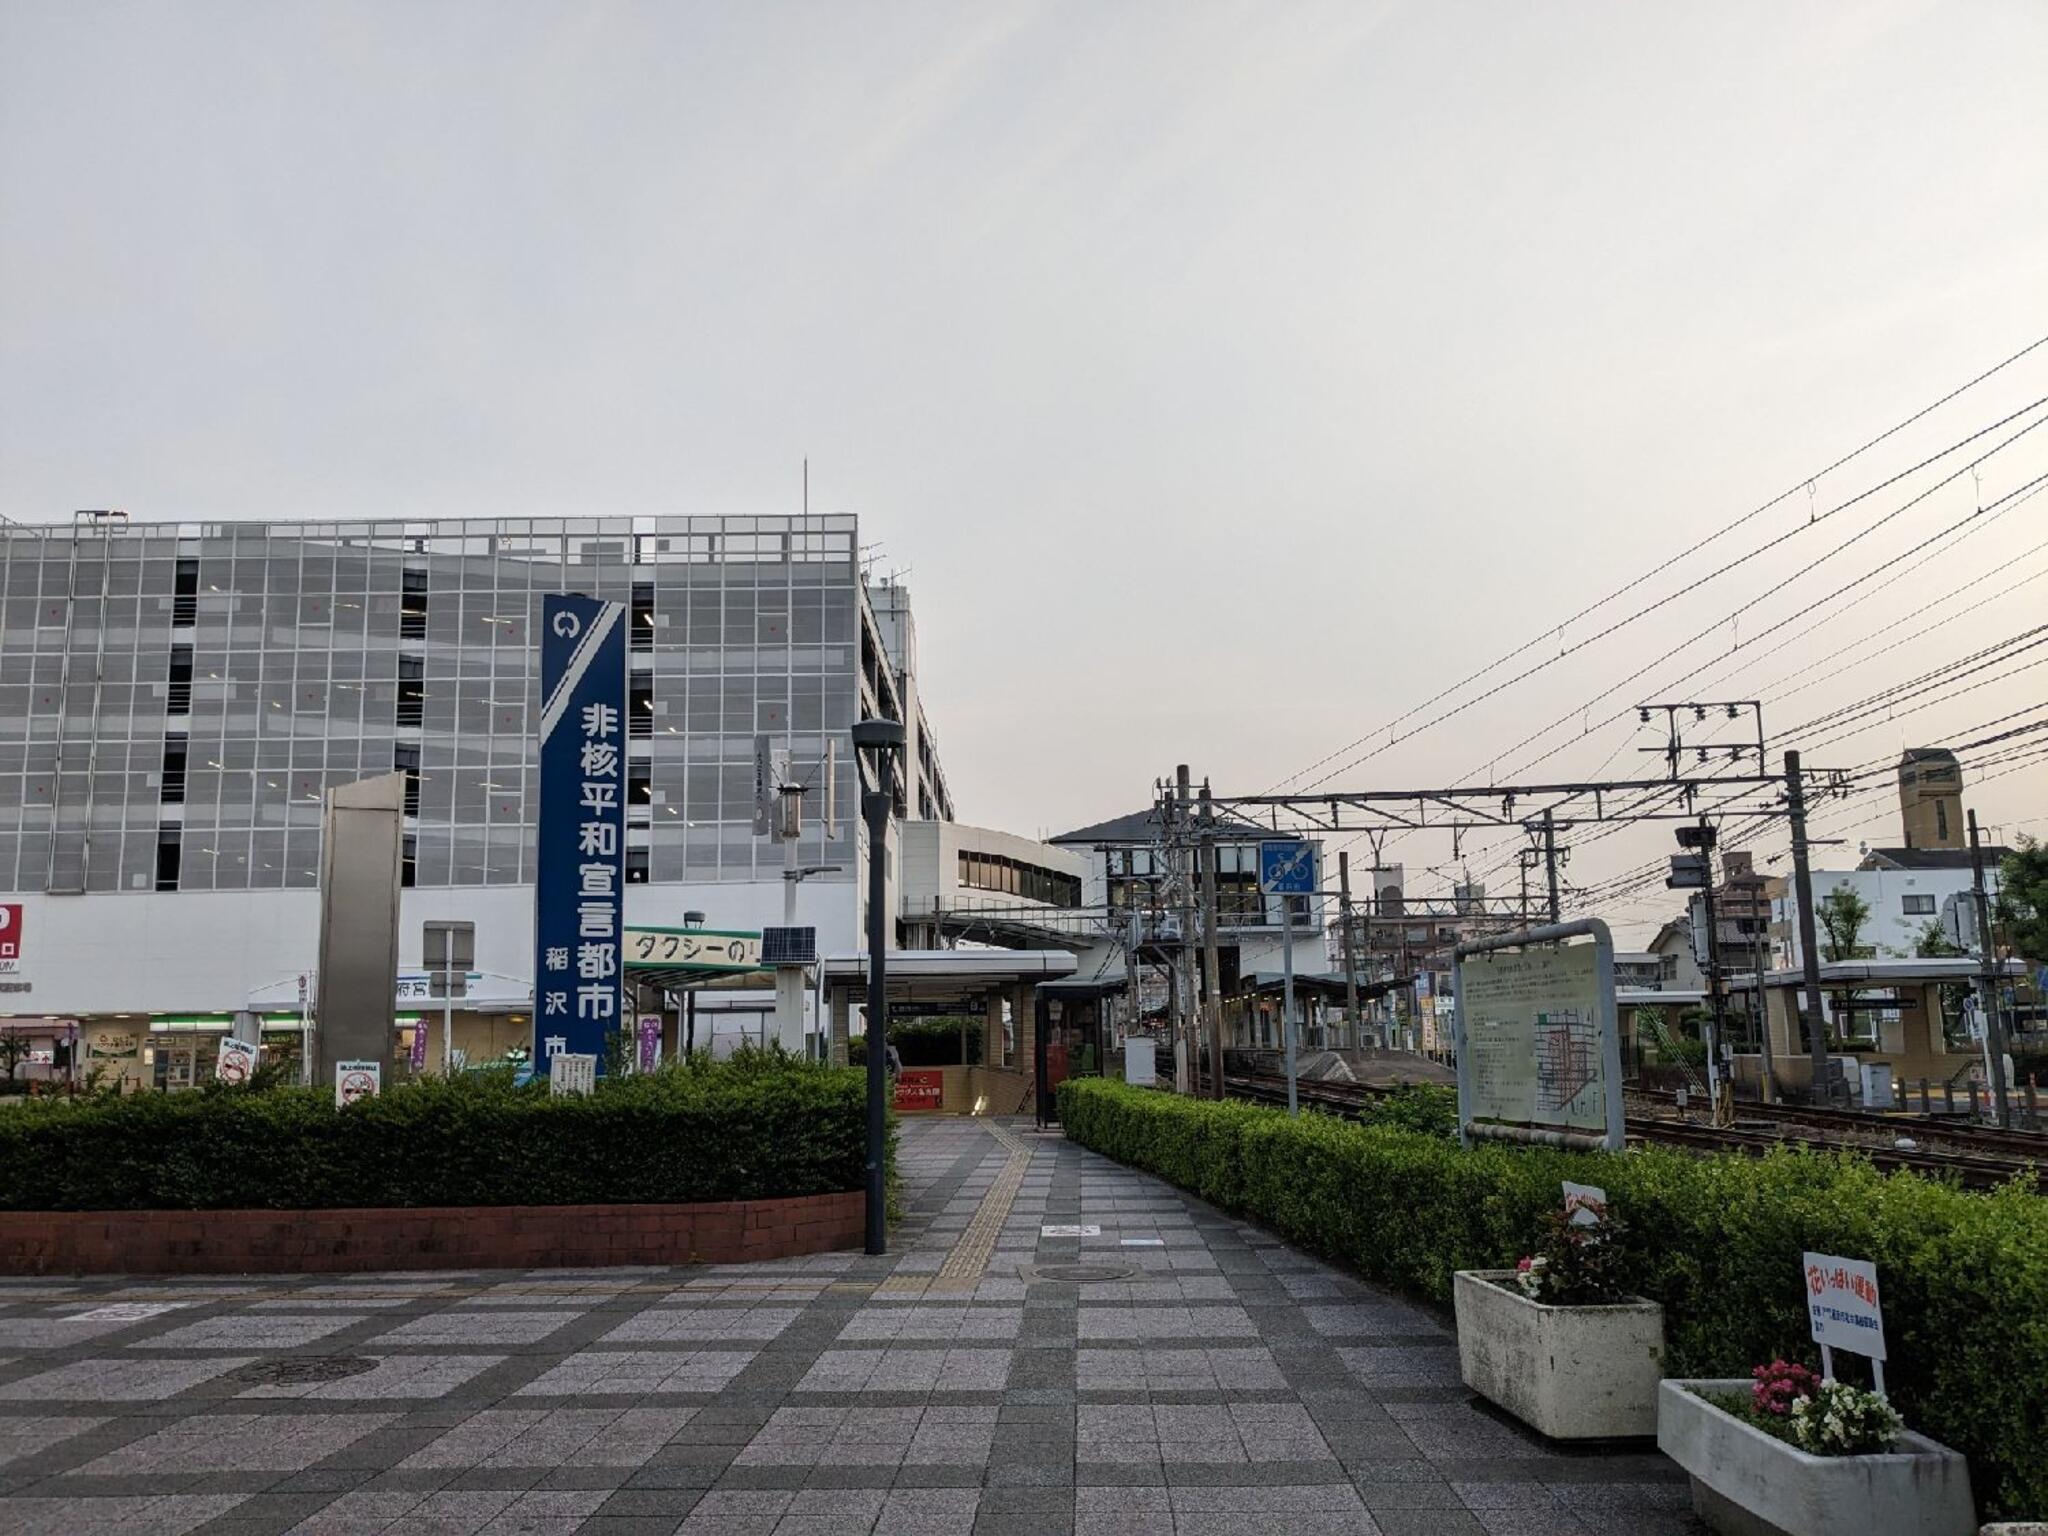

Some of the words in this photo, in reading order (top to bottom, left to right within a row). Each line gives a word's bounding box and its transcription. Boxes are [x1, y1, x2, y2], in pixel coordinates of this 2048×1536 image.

[577, 702, 617, 1020] 非核平和宣言都市
[545, 946, 569, 1056] 稲沢市
[1808, 1265, 1877, 1307] 花いっぱい運動
